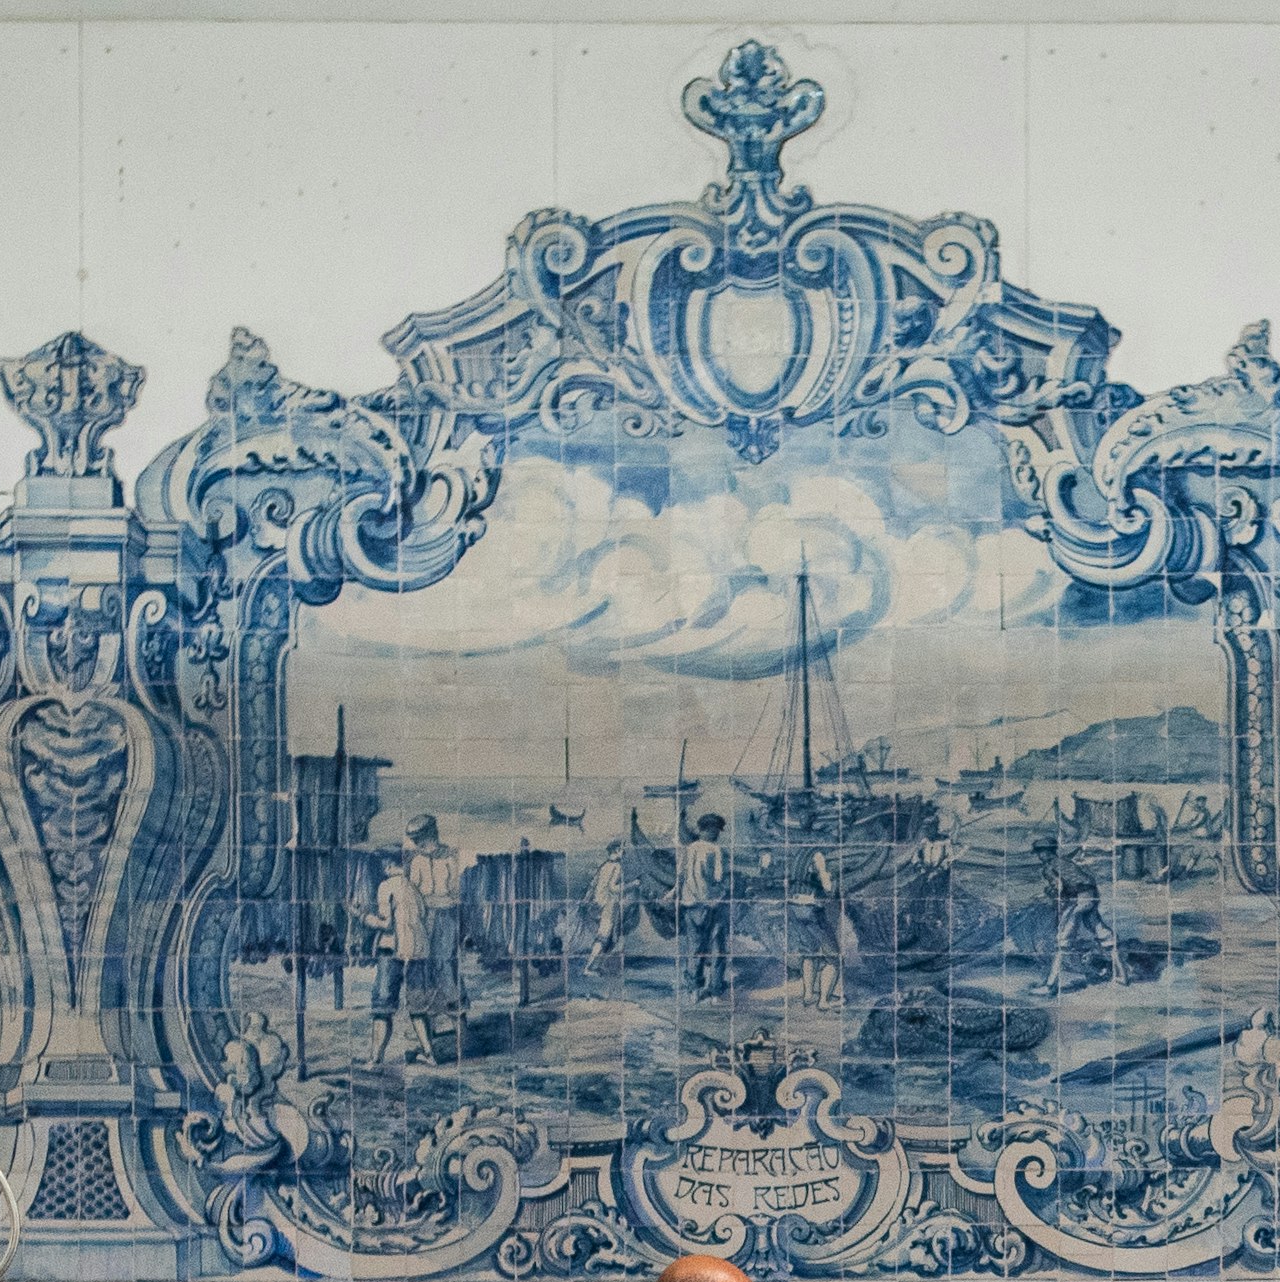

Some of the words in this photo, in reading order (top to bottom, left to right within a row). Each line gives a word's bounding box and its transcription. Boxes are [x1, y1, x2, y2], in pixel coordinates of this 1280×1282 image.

[682, 1141, 840, 1177] REPARAÇÃO
[674, 1175, 731, 1208] DAS
[753, 1176, 840, 1211] REDES
